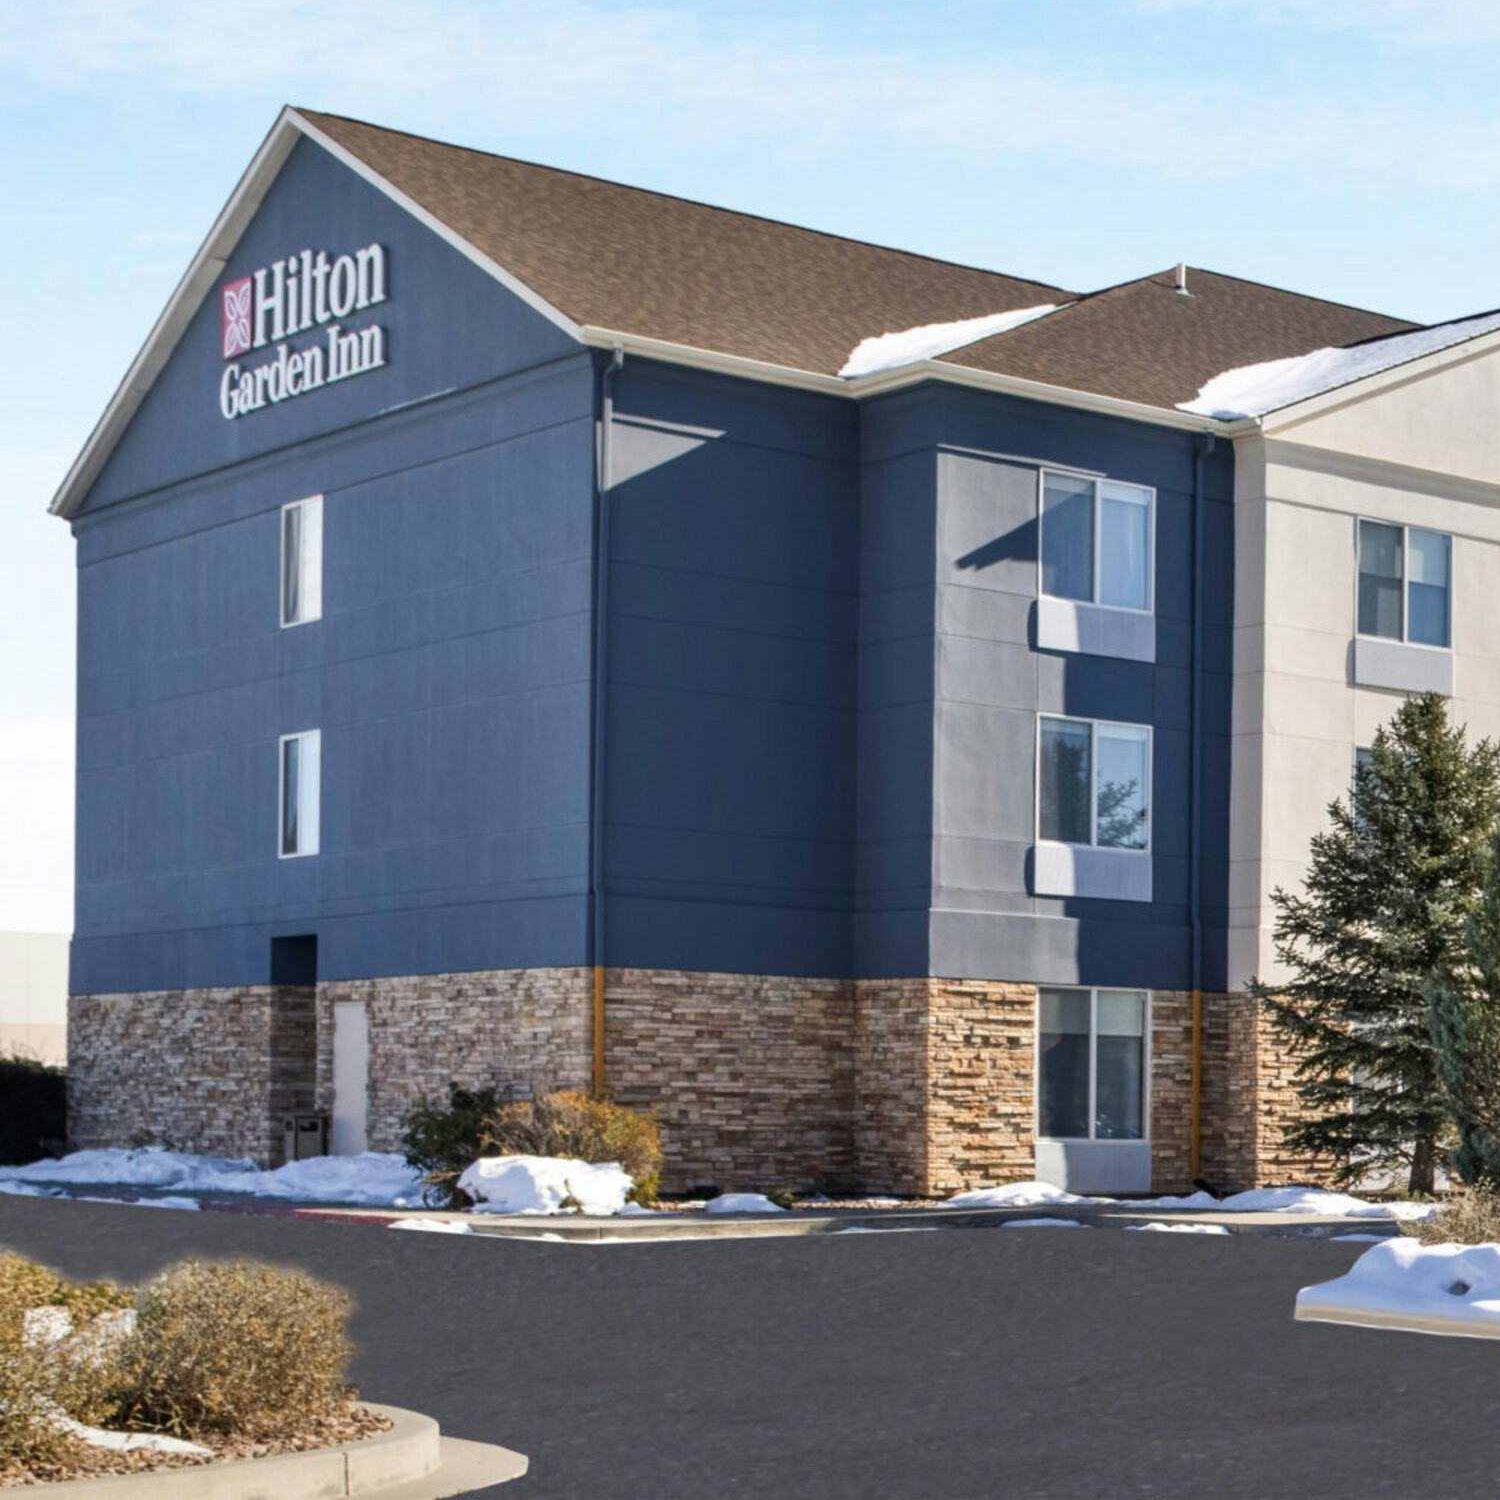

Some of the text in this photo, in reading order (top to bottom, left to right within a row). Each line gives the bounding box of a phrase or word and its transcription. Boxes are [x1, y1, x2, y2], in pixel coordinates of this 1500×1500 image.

[253, 243, 384, 348] Hilton
[220, 324, 384, 419] Garden Inn
